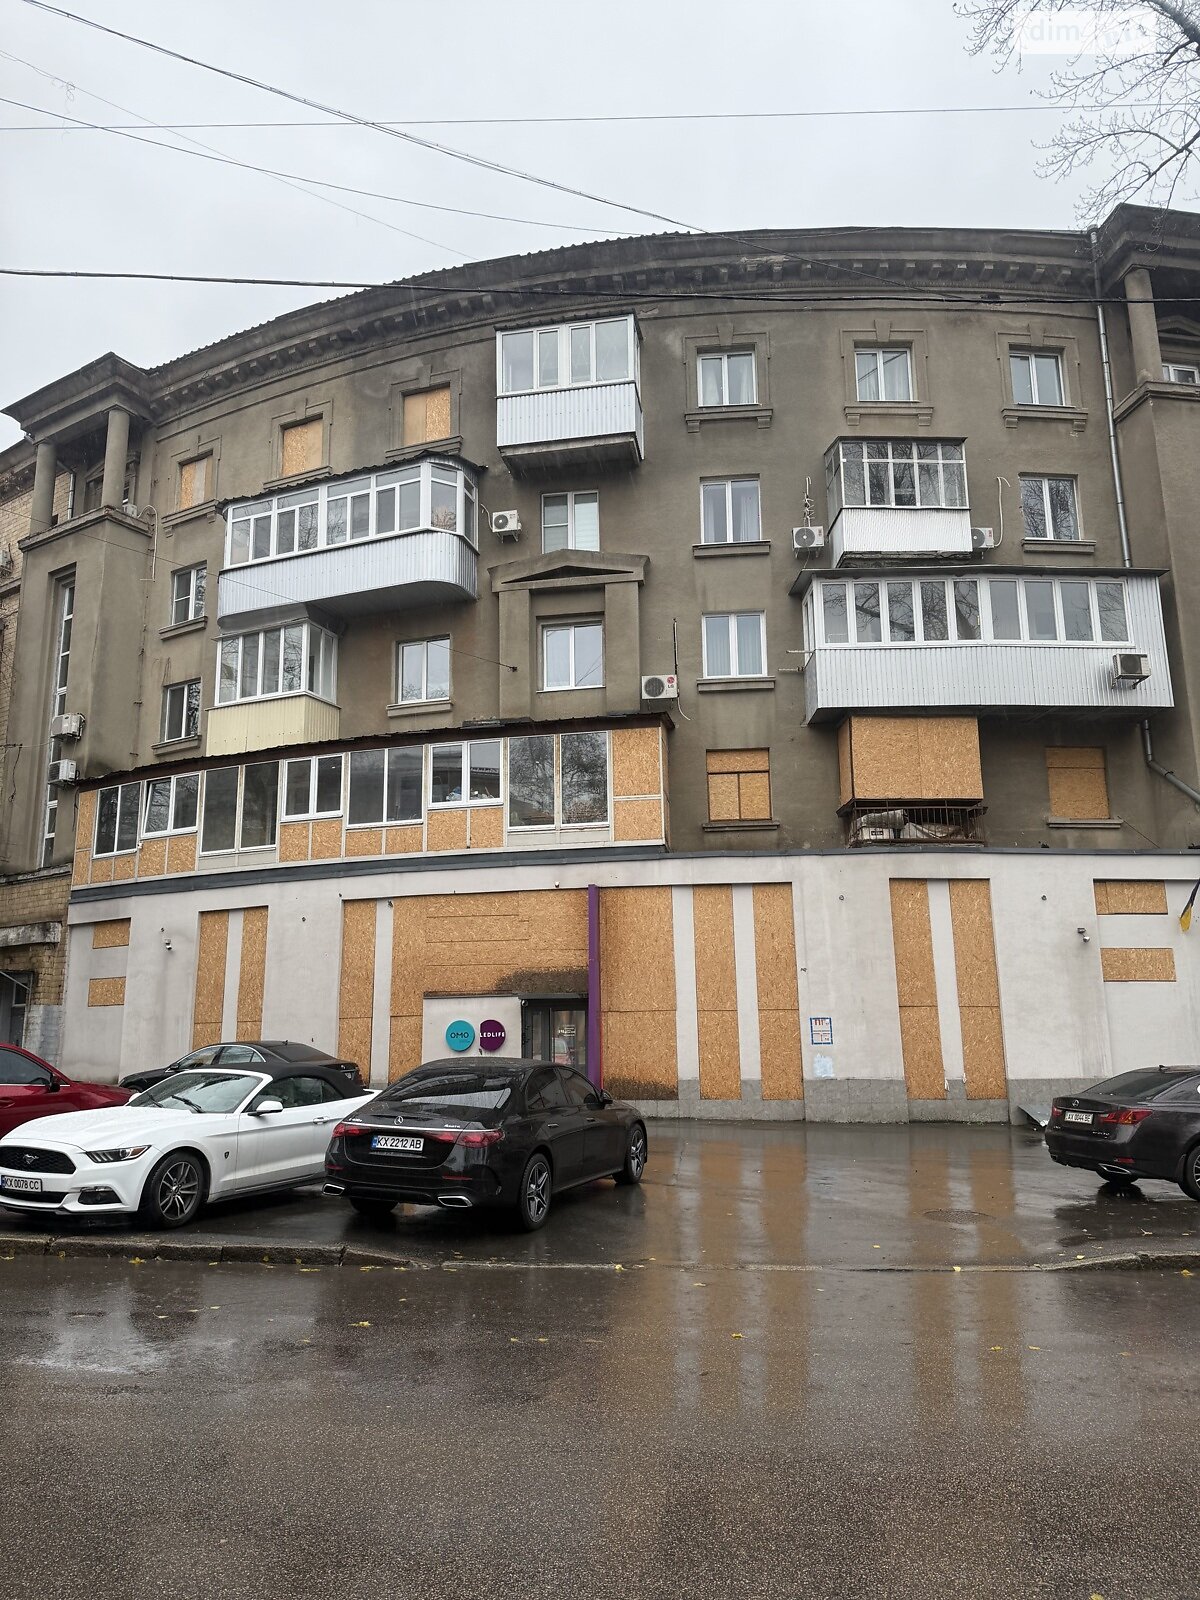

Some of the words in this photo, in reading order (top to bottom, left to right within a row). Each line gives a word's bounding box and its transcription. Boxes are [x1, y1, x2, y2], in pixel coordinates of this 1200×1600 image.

[450, 1031, 470, 1039] OMO
[378, 1137, 390, 1147] KX
[390, 1137, 408, 1148] 2212
[408, 1139, 422, 1149] AB
[14, 1179, 28, 1189] 0078
[29, 1180, 39, 1190] CC
